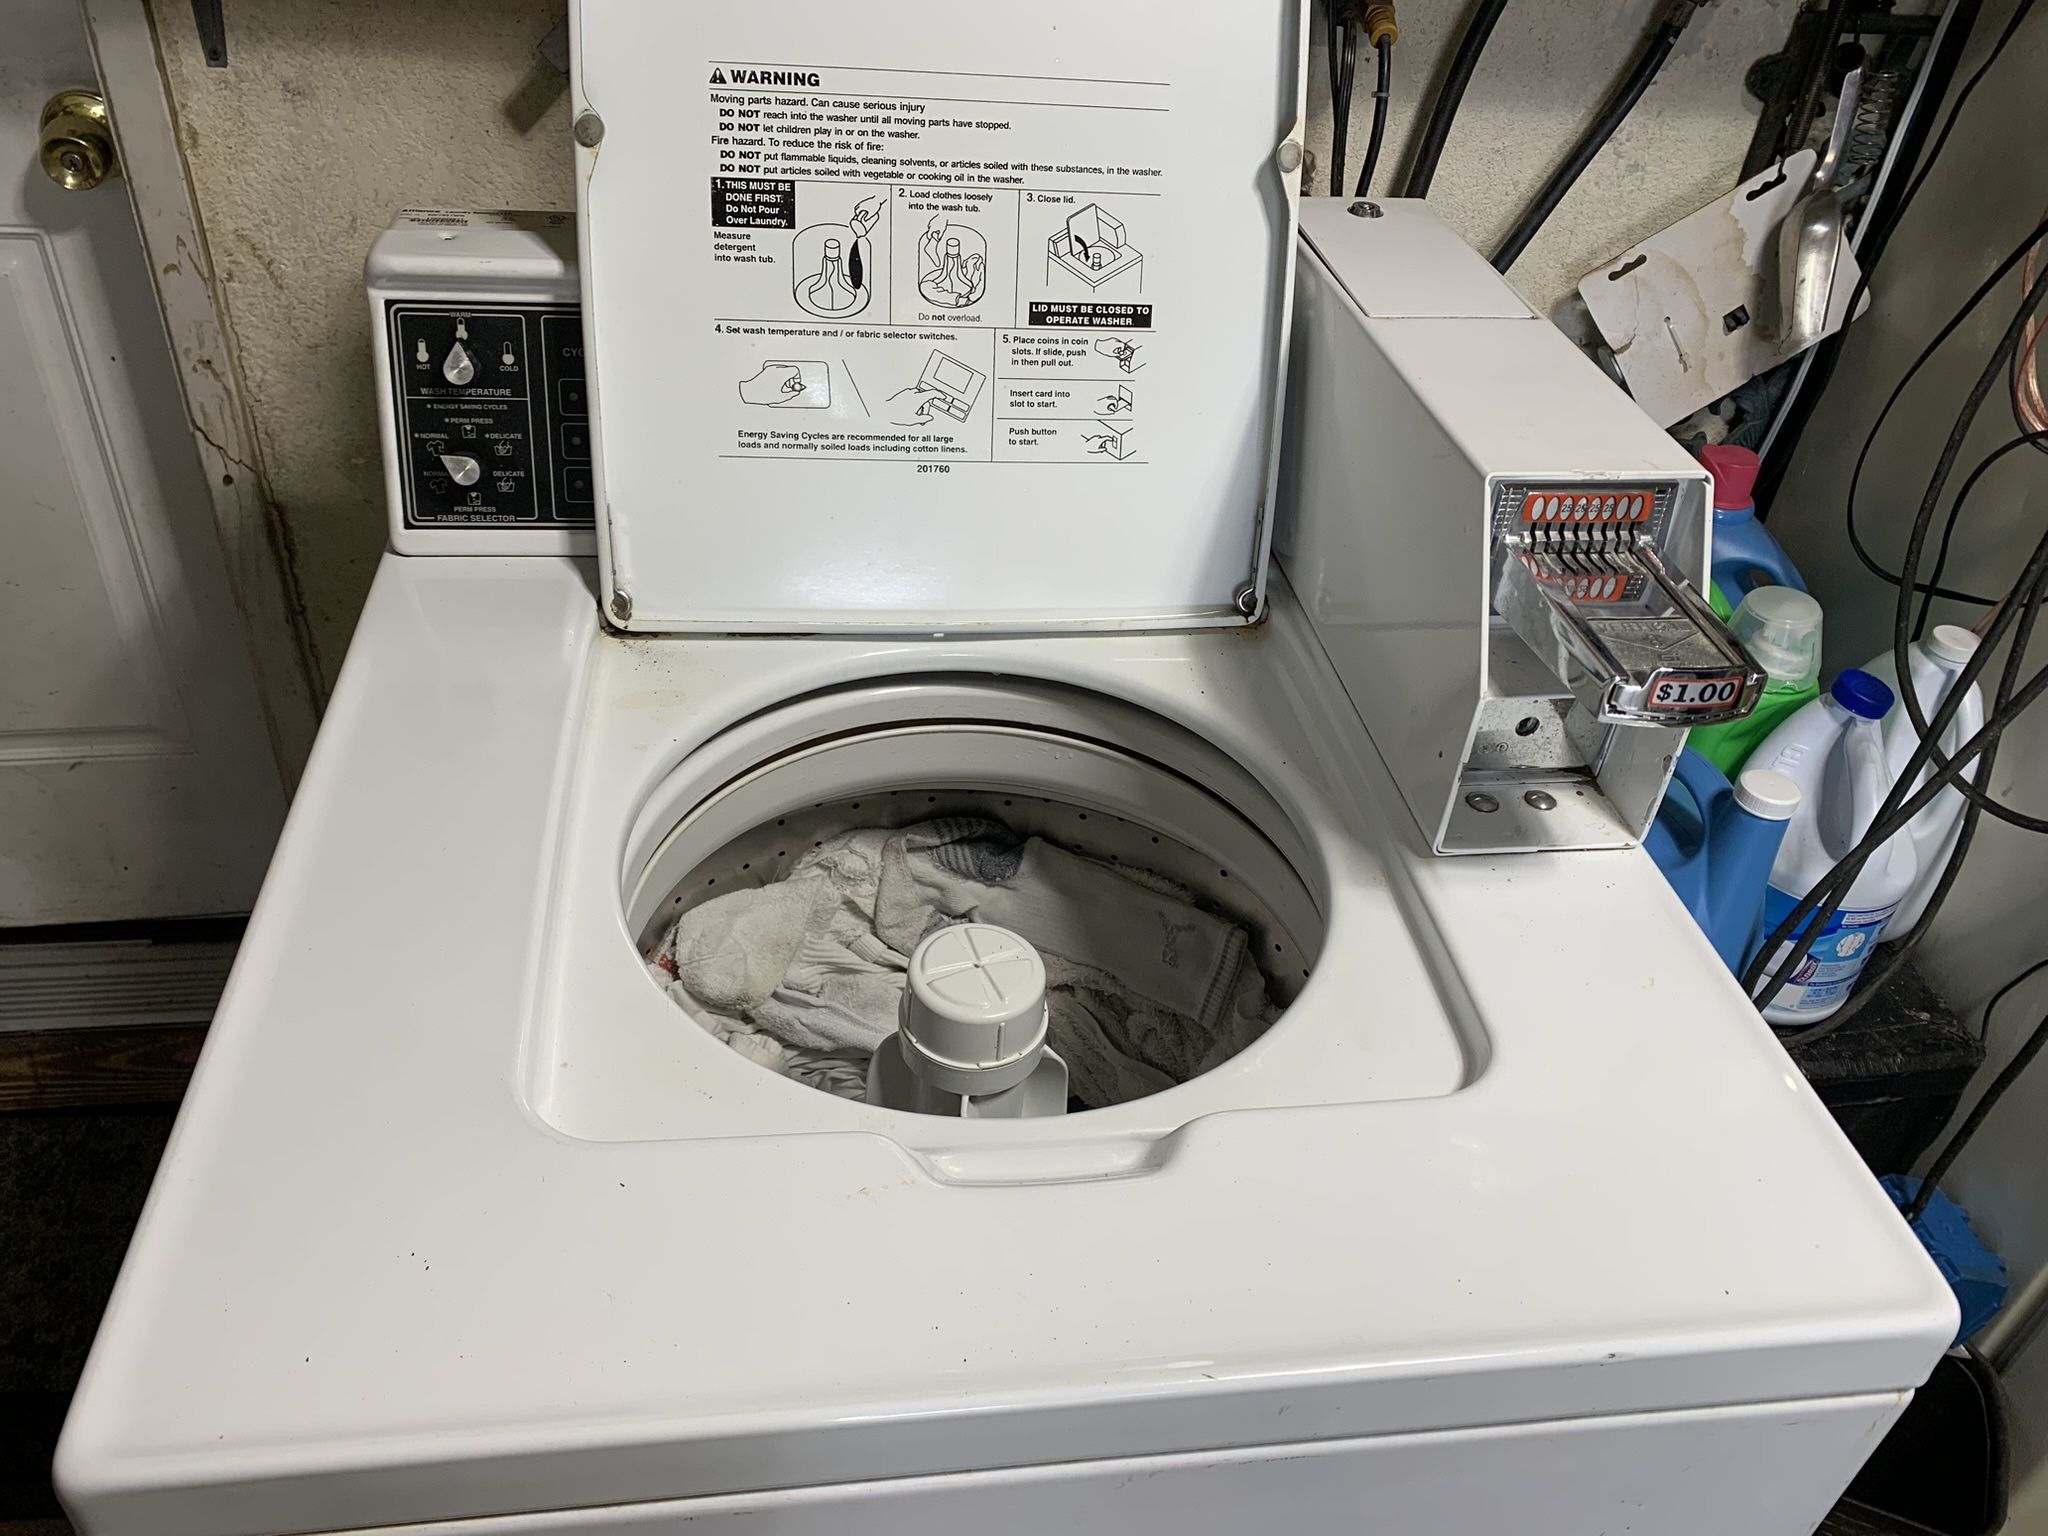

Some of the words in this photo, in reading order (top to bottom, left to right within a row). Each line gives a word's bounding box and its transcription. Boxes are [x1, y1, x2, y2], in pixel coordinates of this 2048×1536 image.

[730, 69, 820, 87] WARNING
[710, 93, 745, 106] Moving
[747, 95, 772, 106] parts
[774, 96, 808, 106] hazard.
[810, 97, 829, 107] Can
[832, 100, 860, 109] cause
[862, 100, 897, 110] serious
[899, 101, 925, 114] injury
[719, 108, 734, 117] DO
[738, 109, 760, 118] NOT
[763, 110, 787, 119] reach
[790, 111, 807, 120] into
[809, 112, 823, 121] the
[825, 113, 857, 122] washer
[860, 114, 879, 123] until
[881, 115, 891, 124] all
[893, 116, 925, 127] moving
[928, 118, 950, 128] parts
[952, 118, 972, 128] have
[975, 120, 1011, 131] stopped.
[719, 122, 734, 131] DO
[737, 122, 760, 132] NOT
[762, 123, 773, 133] let
[776, 124, 811, 134] children
[813, 126, 832, 137] play
[834, 126, 842, 135] in
[871, 128, 885, 137] the
[887, 129, 920, 139] washer.
[711, 135, 729, 145] Fire
[731, 136, 765, 146] hazard.
[767, 137, 780, 146] To
[782, 138, 814, 148] reduce
[816, 139, 832, 149] the
[834, 140, 852, 150] risk
[854, 141, 864, 150] of
[866, 141, 884, 151] fire:
[720, 149, 735, 159] DO
[738, 150, 761, 159] NOT
[763, 152, 778, 162] put
[780, 152, 825, 162] flammable
[827, 154, 859, 165] liquids,
[860, 155, 897, 167] cleaning
[899, 157, 937, 168] solvents,
[950, 159, 981, 169] articles
[983, 161, 1008, 170] soiled
[1010, 162, 1028, 171] with
[1030, 163, 1053, 172] these
[1055, 164, 1104, 175] substances,
[1106, 166, 1114, 174] in
[1116, 166, 1130, 175] the
[1131, 167, 1162, 176] washer.
[715, 179, 725, 189] 1.
[725, 180, 747, 190] THIS
[749, 181, 776, 190] MUST
[778, 182, 791, 191] BE
[725, 192, 752, 202] DONE
[754, 193, 783, 202] FIRST.
[898, 187, 907, 197] 2.
[909, 189, 930, 198] Load
[932, 191, 962, 200] clothes
[963, 192, 993, 202] loosely
[1026, 192, 1035, 202] 3.
[1037, 194, 1061, 203] Close
[1063, 195, 1075, 204] lid.
[725, 203, 738, 212] Do
[740, 204, 756, 213] Not
[758, 205, 780, 214] Pour
[725, 215, 747, 224] Over
[749, 216, 788, 227] Laundry.
[713, 230, 751, 240] Measure
[713, 242, 756, 252] detergent
[714, 253, 731, 261] into
[733, 254, 756, 262] wash
[758, 255, 775, 263] tub.
[1032, 303, 1048, 312] LID
[1050, 304, 1078, 313] MUST
[1080, 305, 1093, 313] BE
[1095, 305, 1134, 314] CLOSED
[1136, 306, 1149, 314] TO
[918, 312, 930, 320] Do
[931, 313, 945, 321] not
[947, 313, 982, 322] overload.
[1045, 315, 1089, 324] OPERATE
[1092, 316, 1132, 325] WASHER
[714, 323, 724, 333] 4.
[725, 325, 740, 334] Set
[742, 326, 765, 334] wash
[767, 327, 820, 337] temperature
[821, 329, 838, 337] and
[839, 329, 843, 337] /
[856, 329, 880, 338] fabric
[882, 331, 916, 339] selector
[918, 332, 957, 340] switches.
[1002, 333, 1011, 343] 5.
[1012, 335, 1035, 344] Place
[1037, 336, 1059, 344] coins
[1061, 336, 1069, 344] in
[1070, 337, 1088, 345] coin
[1011, 347, 1033, 355] slots.
[1035, 347, 1041, 355] If
[1043, 347, 1064, 357] slide,
[1066, 348, 1086, 357] push
[1011, 357, 1019, 365] in
[1020, 358, 1039, 366] then
[1040, 358, 1056, 368] pull
[420, 387, 446, 395] WASH
[448, 388, 512, 396] TEMPERATURE
[1009, 389, 1033, 397] Insert
[1034, 389, 1053, 397] card
[1054, 389, 1070, 397] into
[1009, 399, 1025, 407] slot
[1037, 400, 1057, 408] start.
[737, 429, 768, 440] Energy
[770, 430, 799, 441] Saving
[801, 431, 829, 441] Cycles
[846, 433, 906, 441] recommended
[907, 434, 919, 442] for
[921, 434, 931, 442] all
[933, 434, 954, 444] large
[1008, 427, 1029, 435] Push
[1031, 427, 1057, 435] button
[916, 464, 950, 473] 201760
[1561, 503, 1572, 513] 25
[437, 514, 468, 522] FABRIC
[470, 514, 516, 522] SELECTOR
[1656, 681, 1737, 703] $1.00
